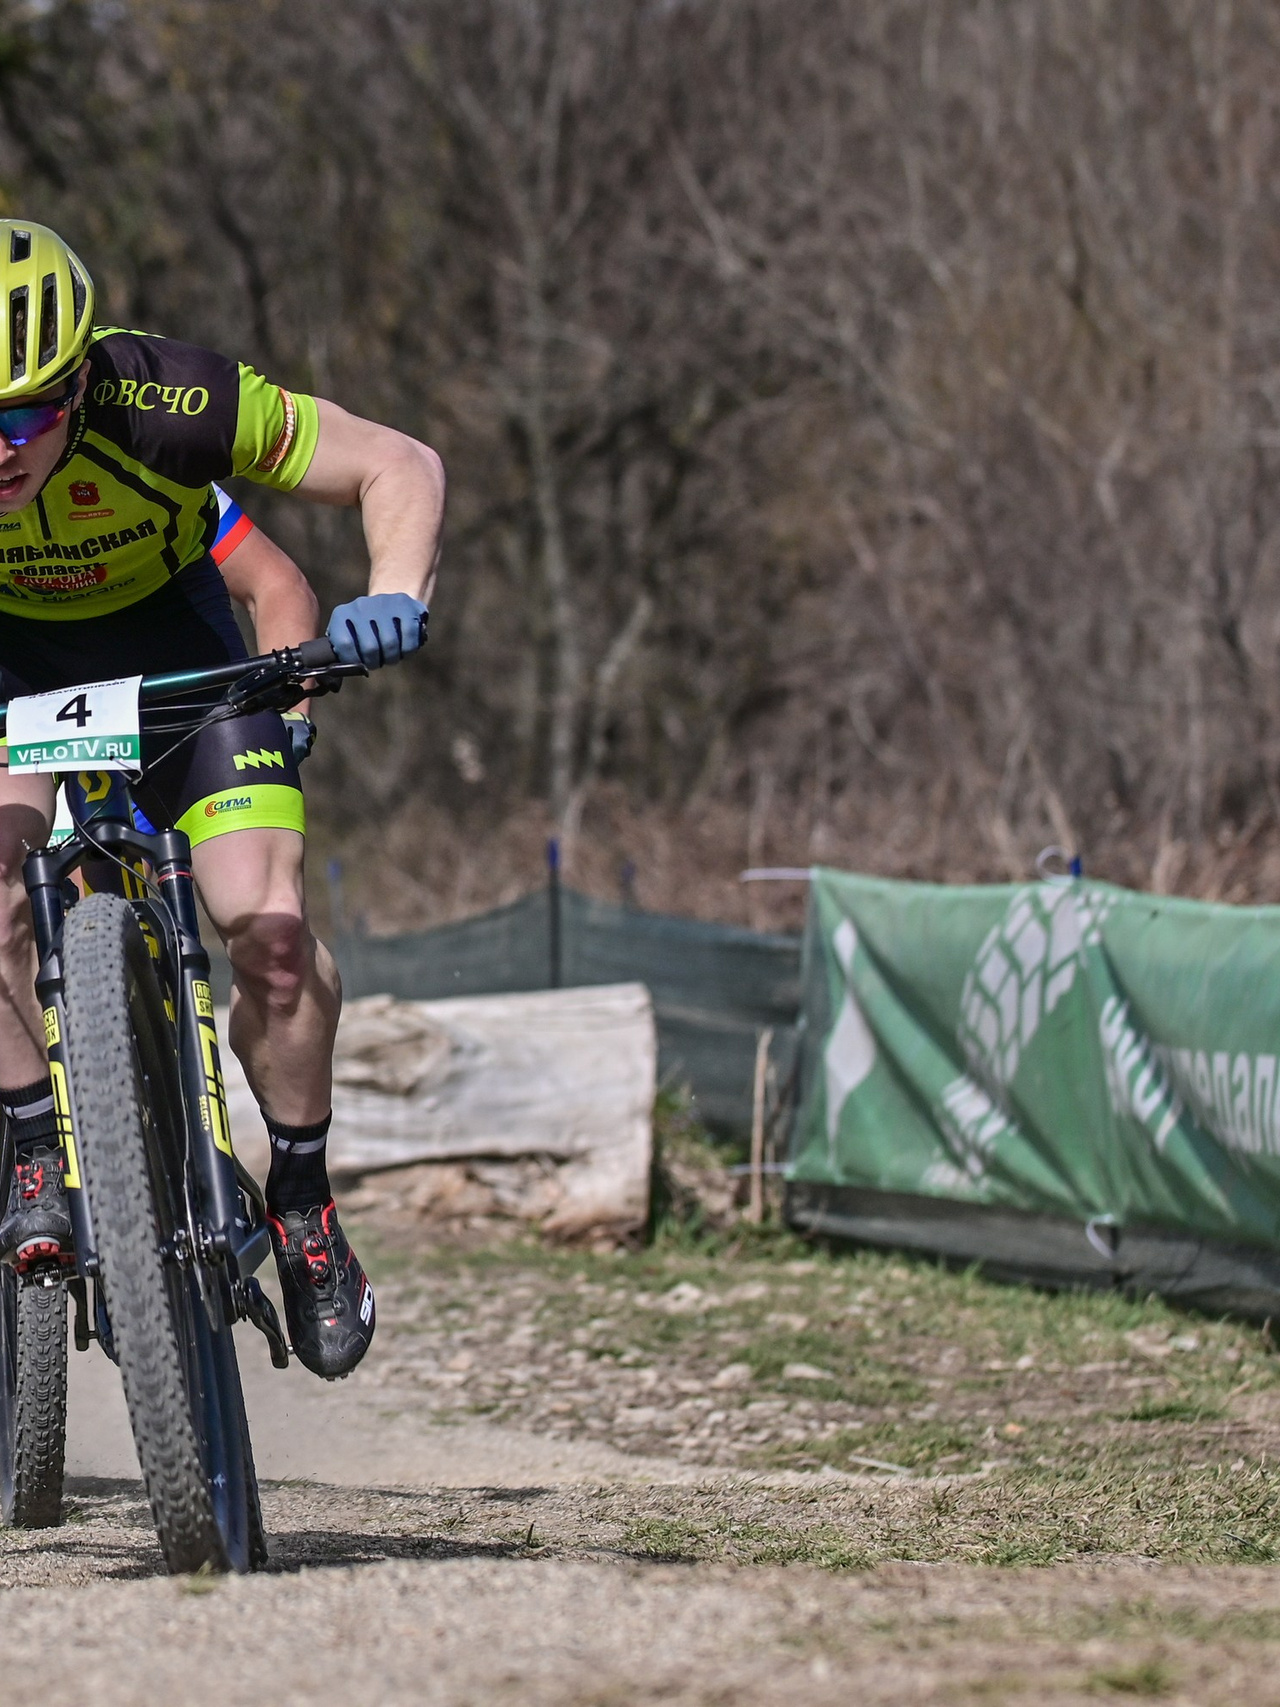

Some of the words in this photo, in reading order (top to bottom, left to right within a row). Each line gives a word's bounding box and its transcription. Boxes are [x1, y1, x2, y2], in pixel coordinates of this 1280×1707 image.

[93, 379, 209, 415] ФВСЧО
[56, 693, 92, 728] 4
[16, 740, 132, 763] VELOTV.RU
